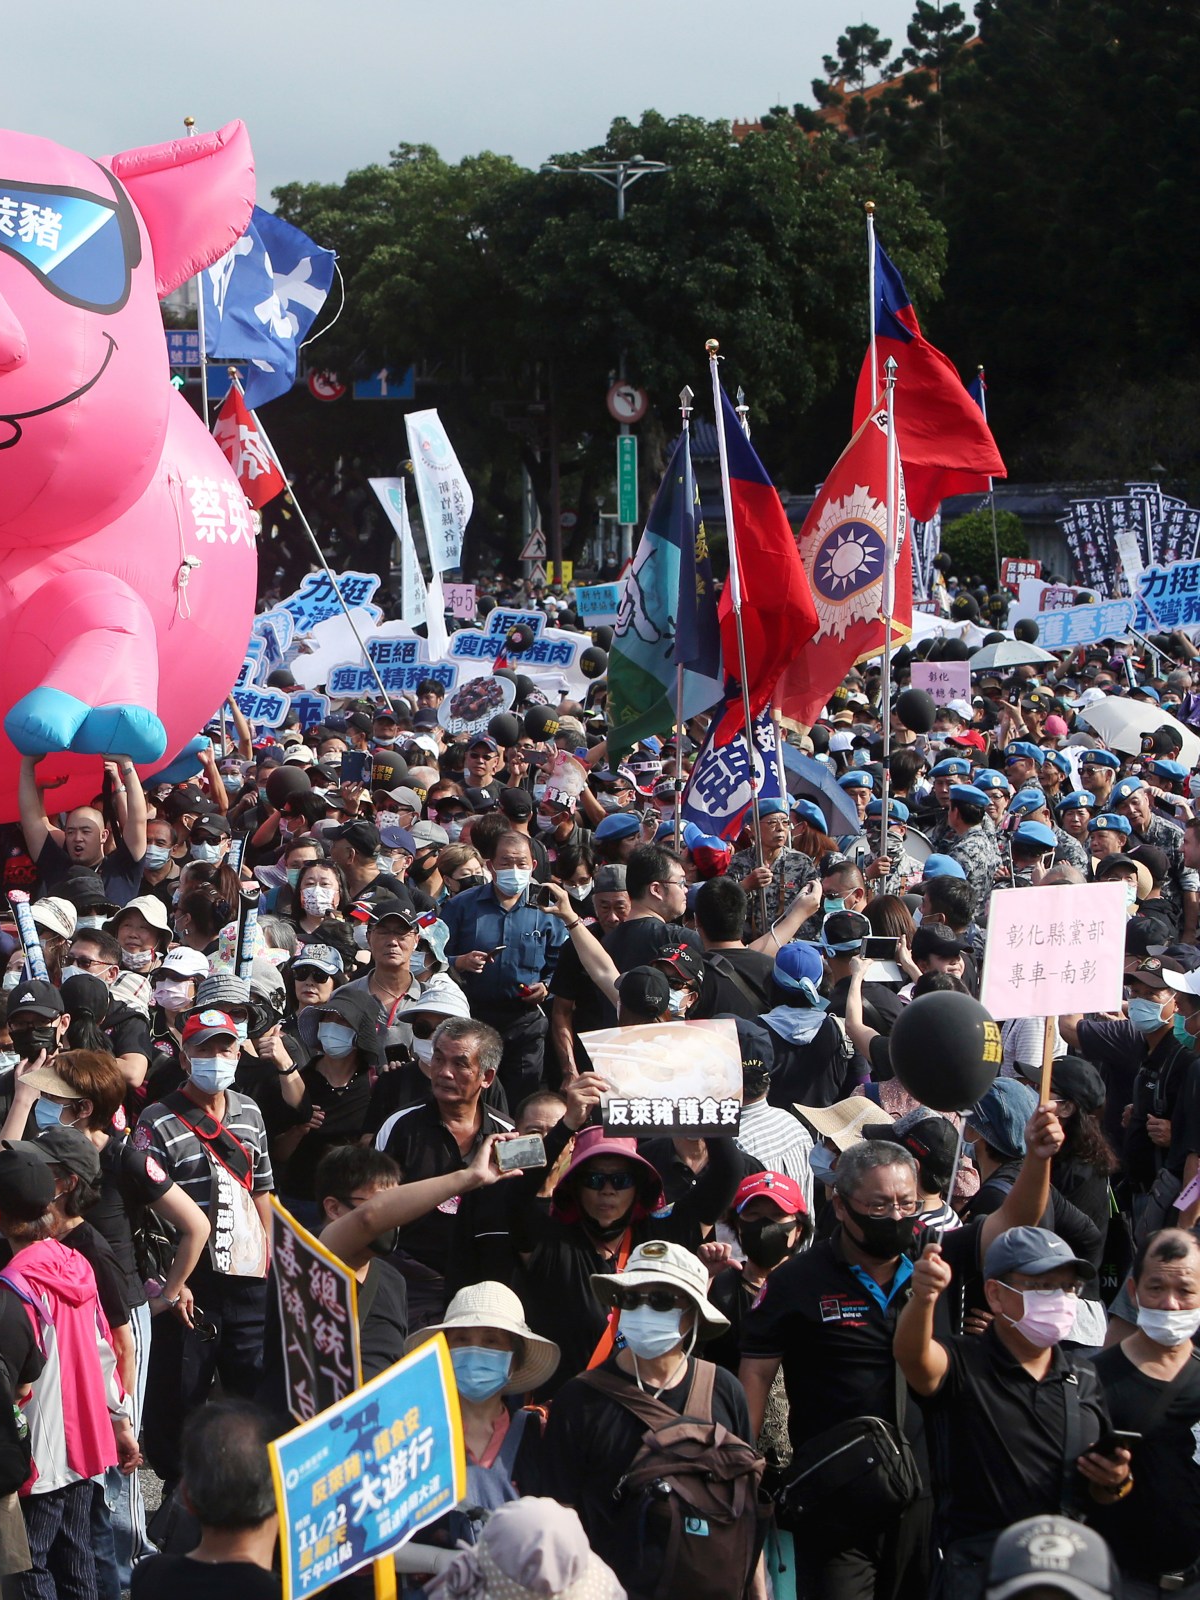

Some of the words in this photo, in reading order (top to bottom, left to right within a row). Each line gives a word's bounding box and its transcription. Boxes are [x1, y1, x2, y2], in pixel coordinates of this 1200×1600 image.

[166, 333, 199, 348] 車道
[186, 475, 257, 551] 蔡英
[300, 575, 372, 606] 力挺
[1141, 565, 1200, 598] 力挺
[444, 588, 473, 612] 和5
[368, 641, 416, 663] 拒絕
[928, 671, 950, 682] 彰化
[223, 690, 284, 721] 豬肉
[1006, 920, 1105, 949] 彰化縣黨部
[742, 1059, 764, 1068] NAVY
[607, 1098, 675, 1126] 反萊豬
[677, 1096, 741, 1126] 護食安
[215, 1209, 232, 1272] 護食安
[308, 1261, 352, 1403] 總統下
[353, 1426, 434, 1524] 大遊行
[298, 1503, 348, 1551] 11/22
